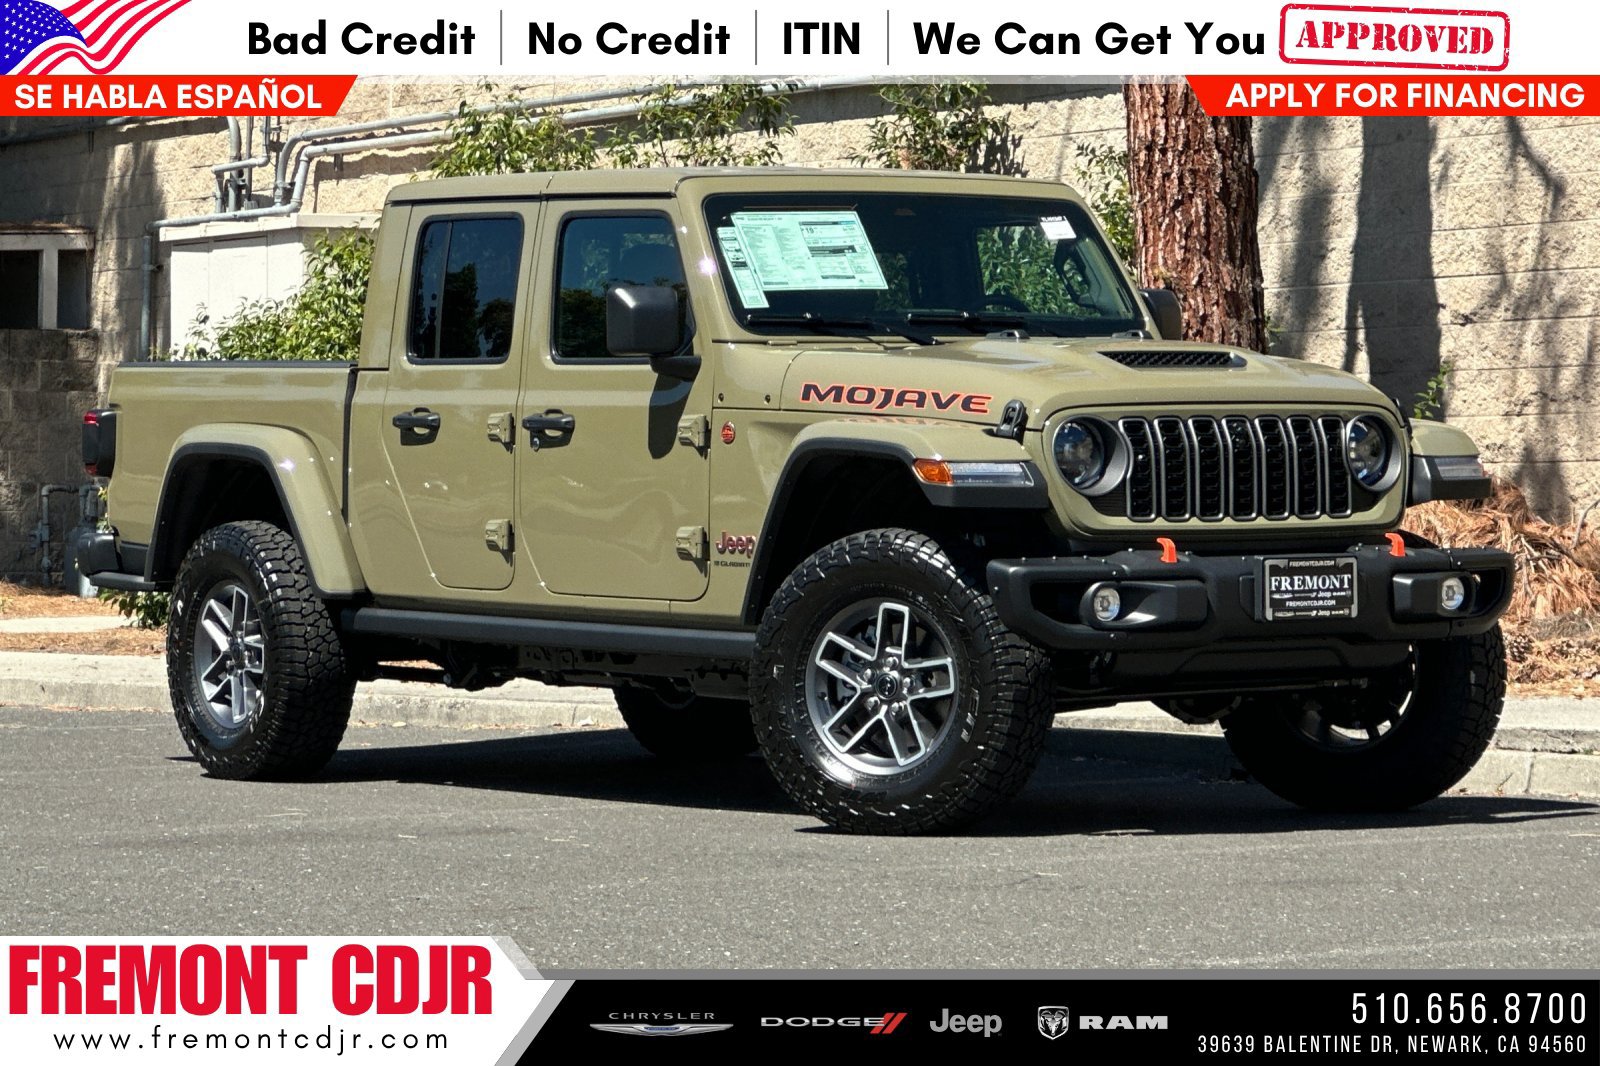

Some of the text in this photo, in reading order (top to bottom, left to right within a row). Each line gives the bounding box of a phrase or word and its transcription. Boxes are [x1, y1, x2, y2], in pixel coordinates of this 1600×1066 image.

[800, 382, 992, 415] MOJAVE
[715, 531, 756, 559] Jeep
[1270, 574, 1352, 591] FREMONT
